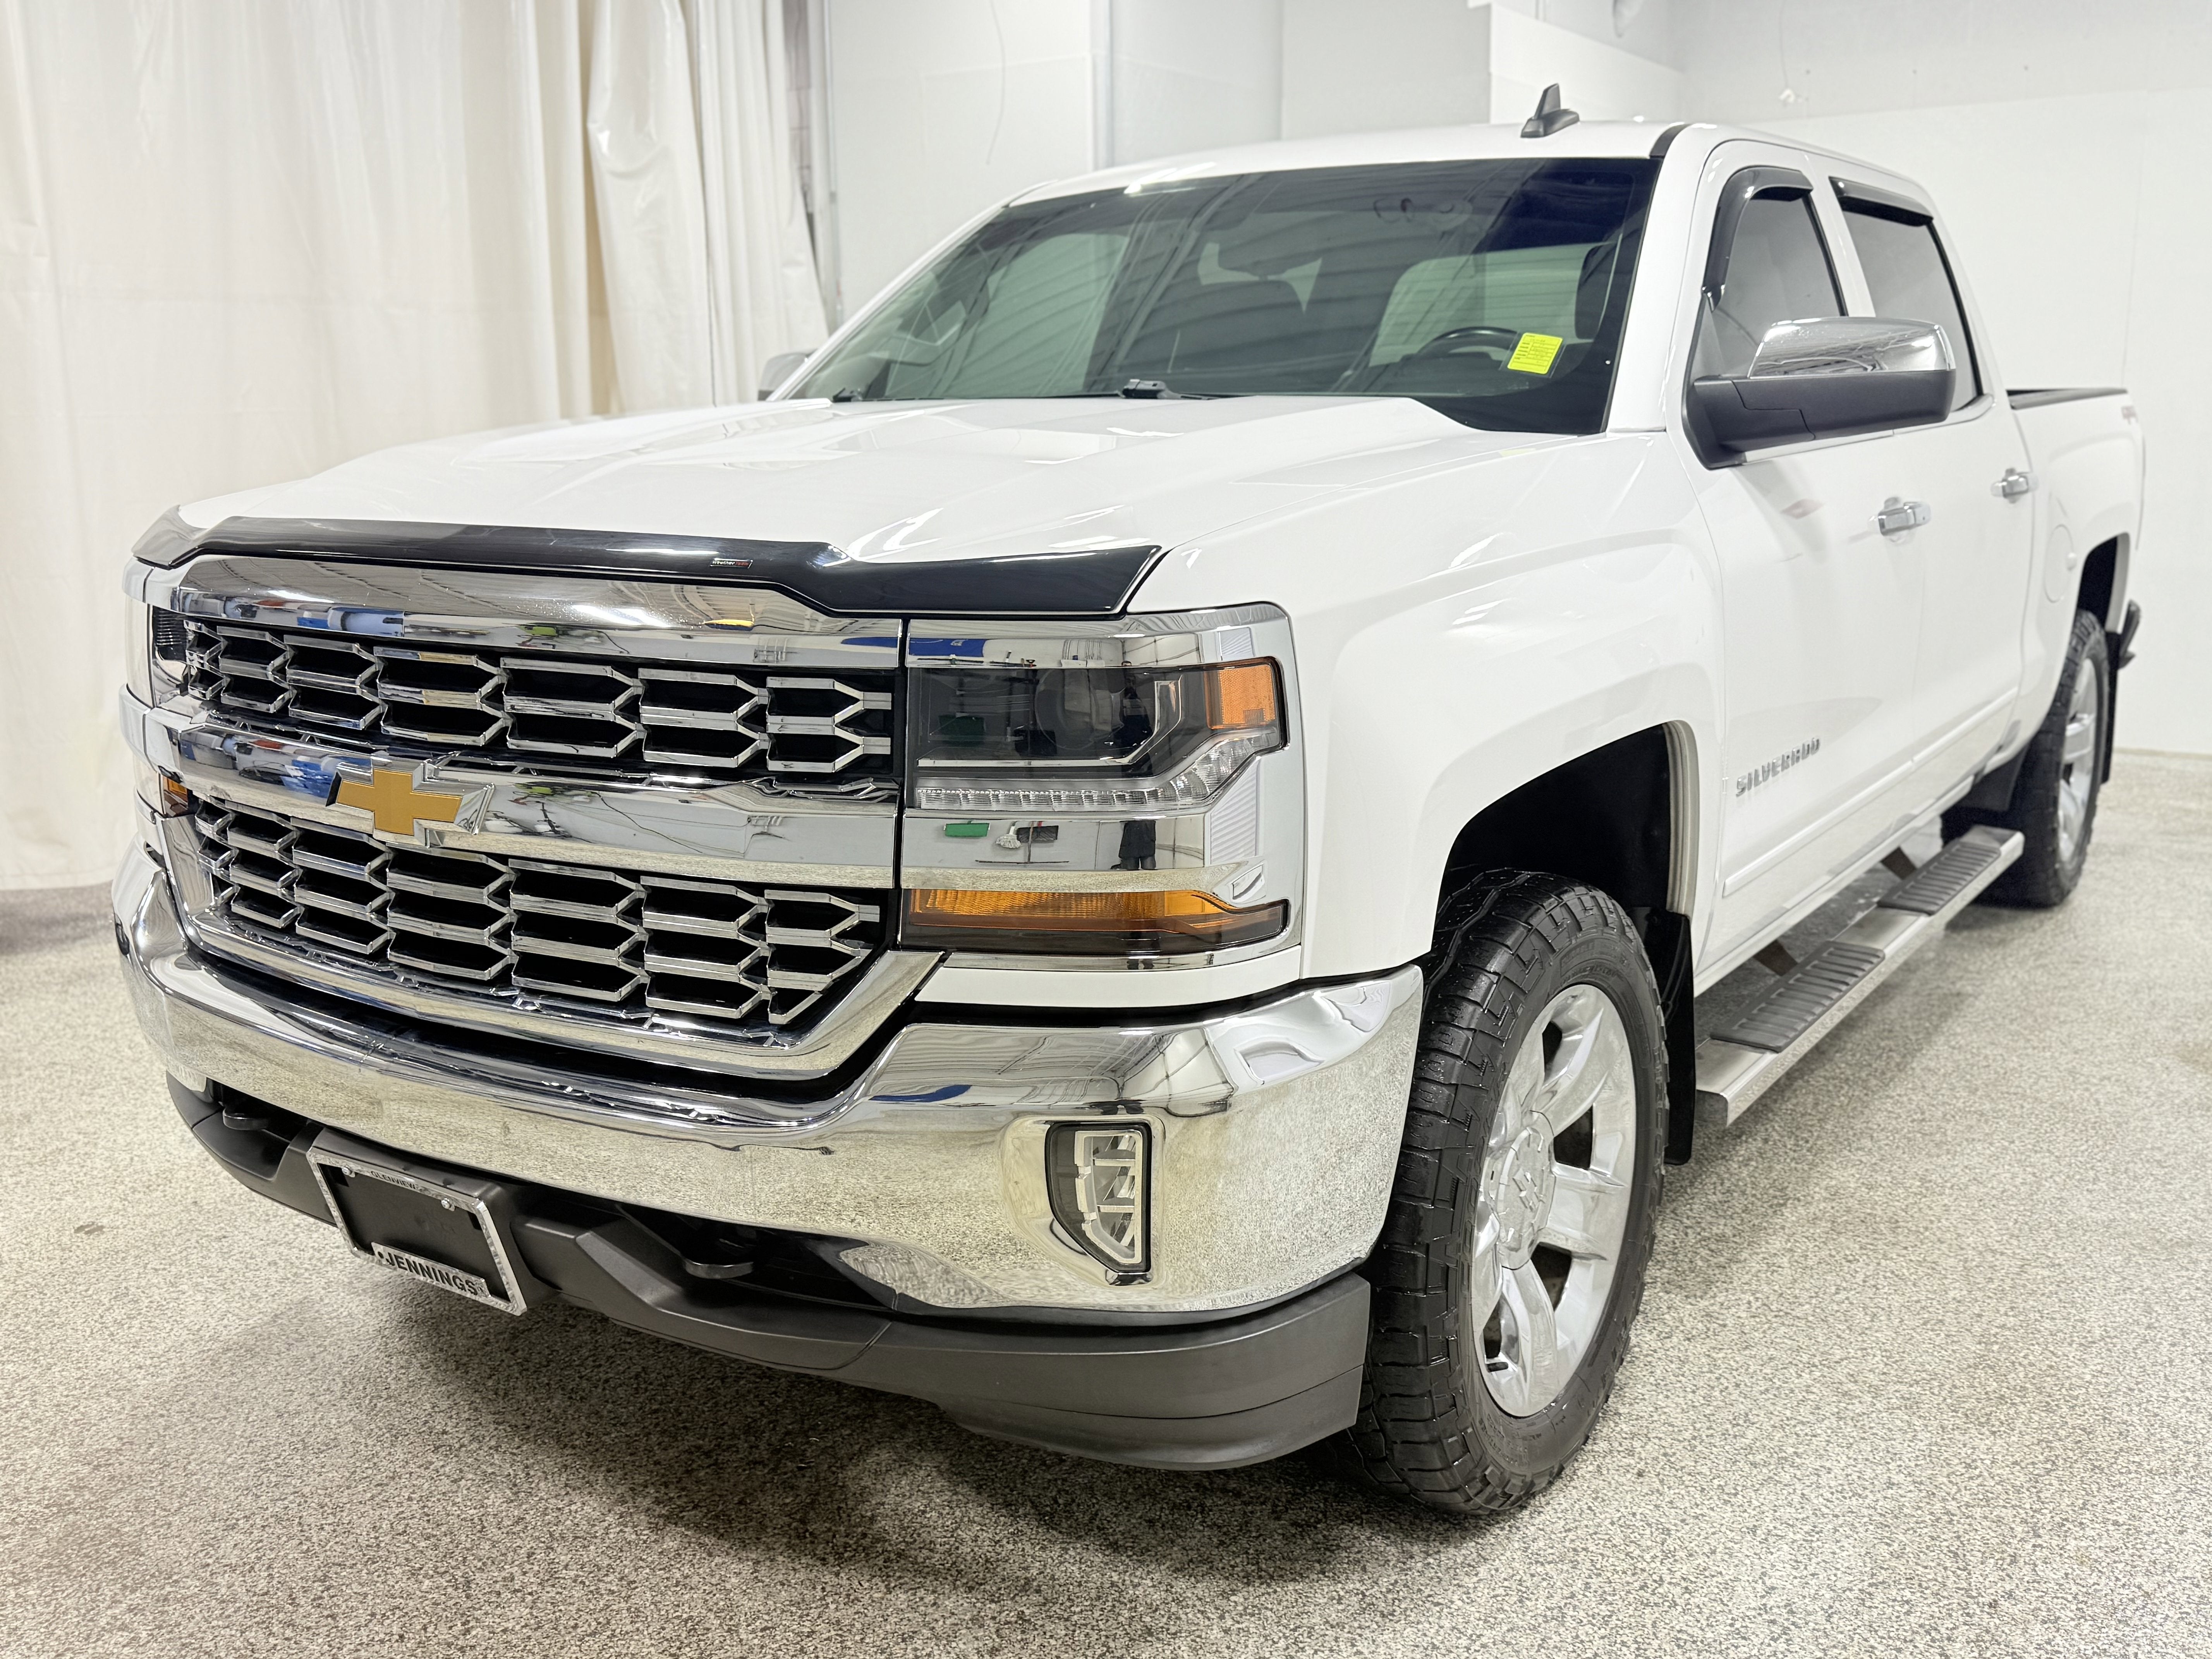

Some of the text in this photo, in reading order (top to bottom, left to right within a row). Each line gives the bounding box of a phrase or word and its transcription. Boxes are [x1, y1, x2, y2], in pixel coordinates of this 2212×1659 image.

[1736, 737, 1820, 797] SILVERADO
[371, 1171, 416, 1189] GLENVIEW
[386, 1252, 478, 1296] JENNINGS
